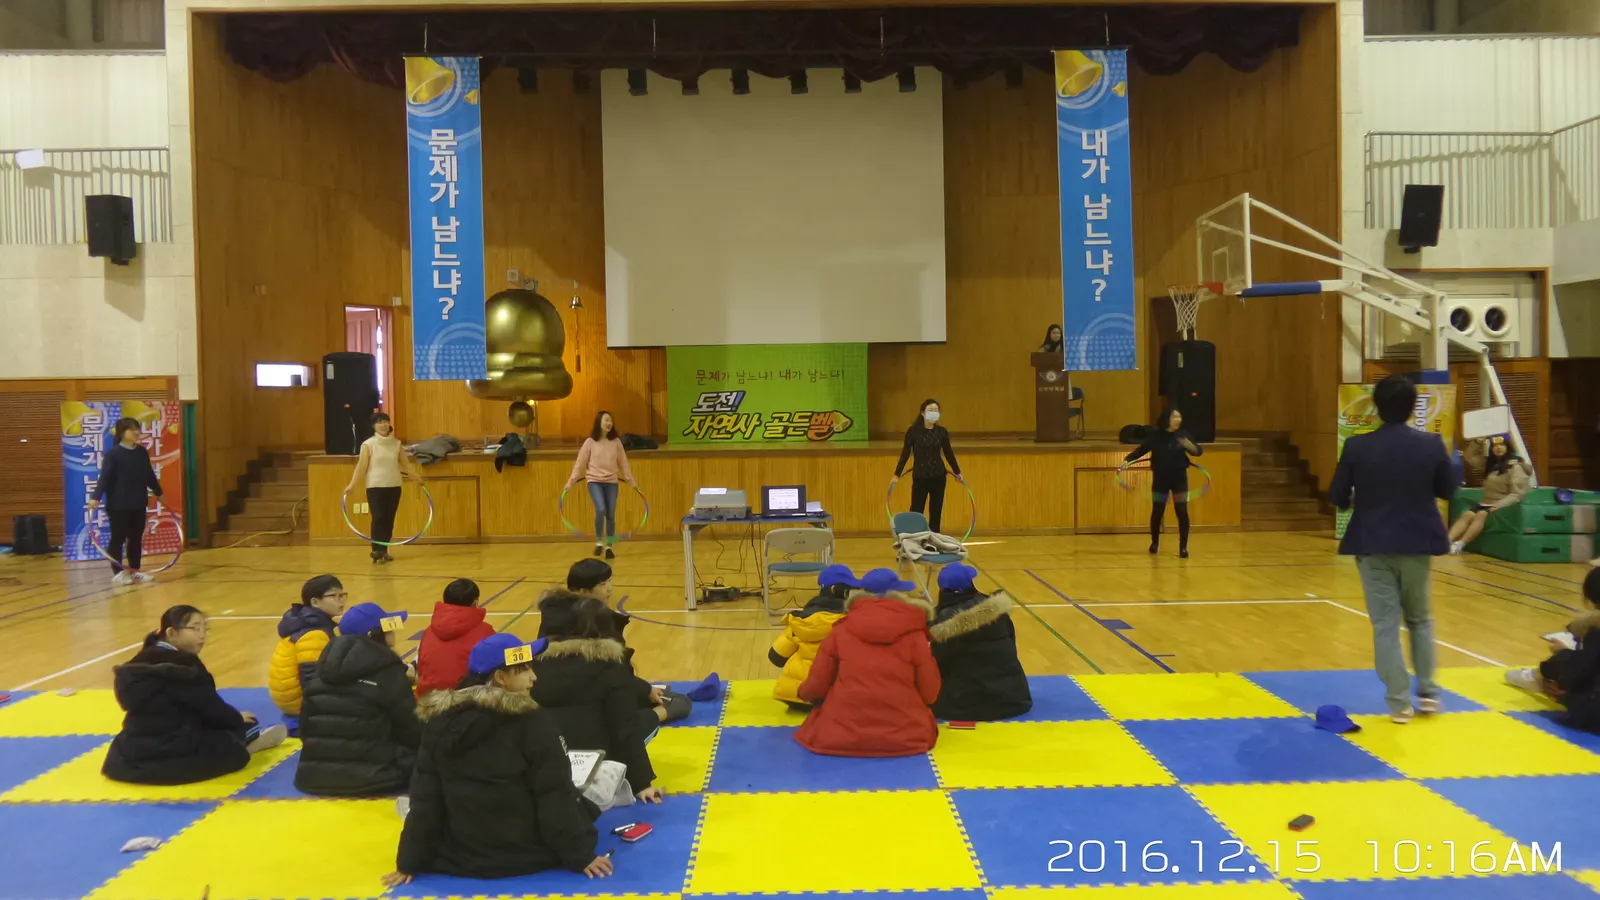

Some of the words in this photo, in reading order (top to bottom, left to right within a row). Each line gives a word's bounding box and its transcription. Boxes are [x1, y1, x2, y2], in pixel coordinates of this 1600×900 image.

[428, 128, 460, 209] 문제가
[1081, 129, 1111, 184] 내가
[431, 215, 462, 320] 남느냐?
[1083, 193, 1114, 302] 남느냐?
[695, 369, 730, 386] 문제가
[736, 370, 773, 385] 남느냐!
[779, 369, 802, 381] 내가
[807, 369, 845, 384] 남느냐!
[691, 390, 746, 413] 도전!
[81, 415, 104, 469] 문제가
[140, 420, 163, 456] 내가
[683, 412, 762, 440] 자연사
[763, 410, 848, 441] 골든벨
[512, 652, 524, 662] 30
